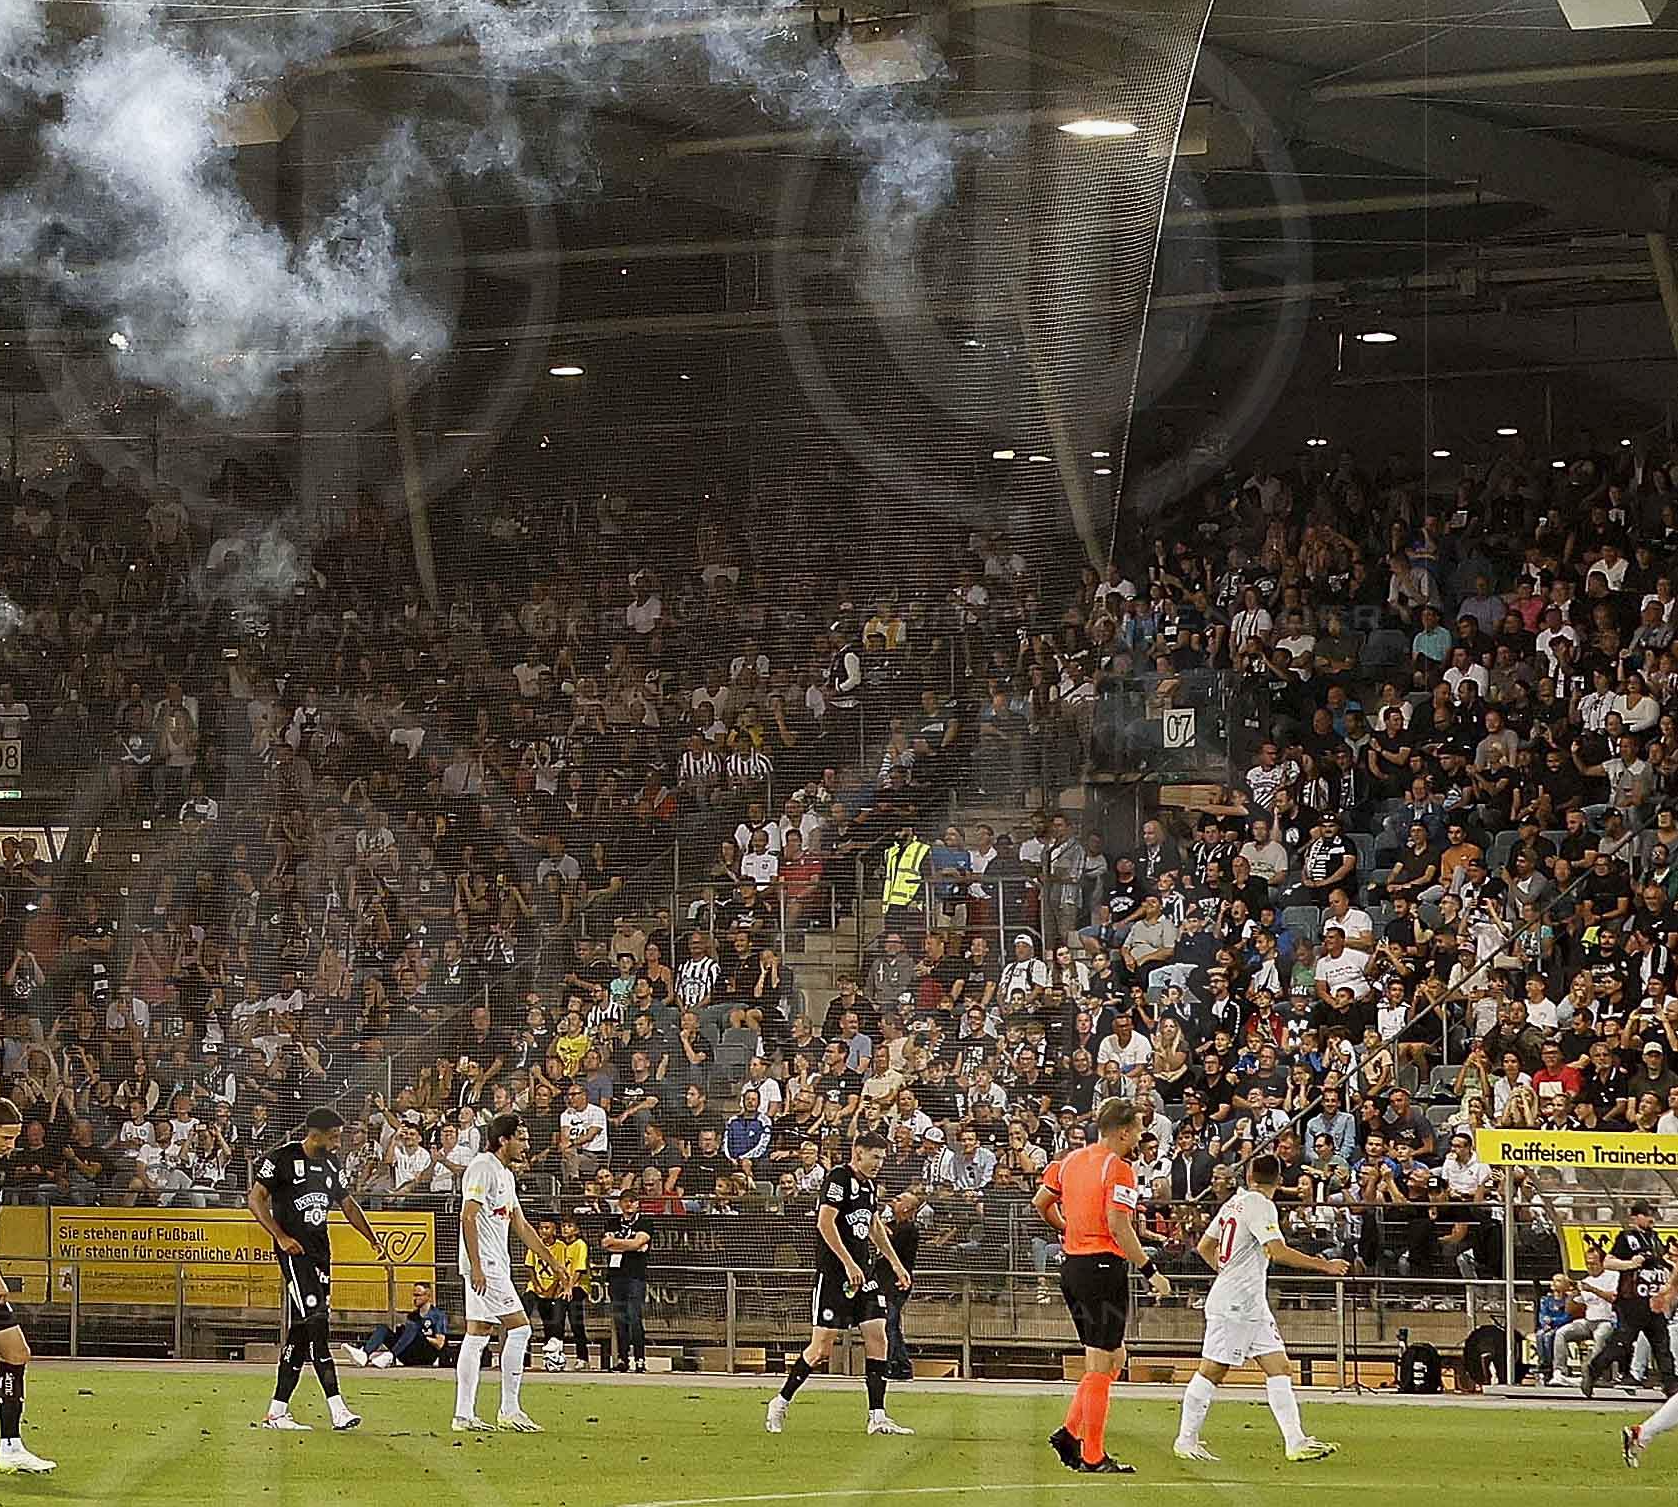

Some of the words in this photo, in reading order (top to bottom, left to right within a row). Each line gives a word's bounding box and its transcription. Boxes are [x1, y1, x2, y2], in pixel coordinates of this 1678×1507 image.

[1167, 715, 1191, 742] 07
[1501, 1143, 1585, 1163] Raiffeisen
[59, 1226, 79, 1239] Sie
[84, 1227, 127, 1240] stehen
[132, 1227, 153, 1241] auf
[156, 1228, 209, 1242] Fußball.
[59, 1245, 81, 1258] Wir
[86, 1245, 129, 1259] stehen
[133, 1245, 153, 1259] für
[156, 1246, 231, 1261] persönliche
[235, 1248, 249, 1261] A1
